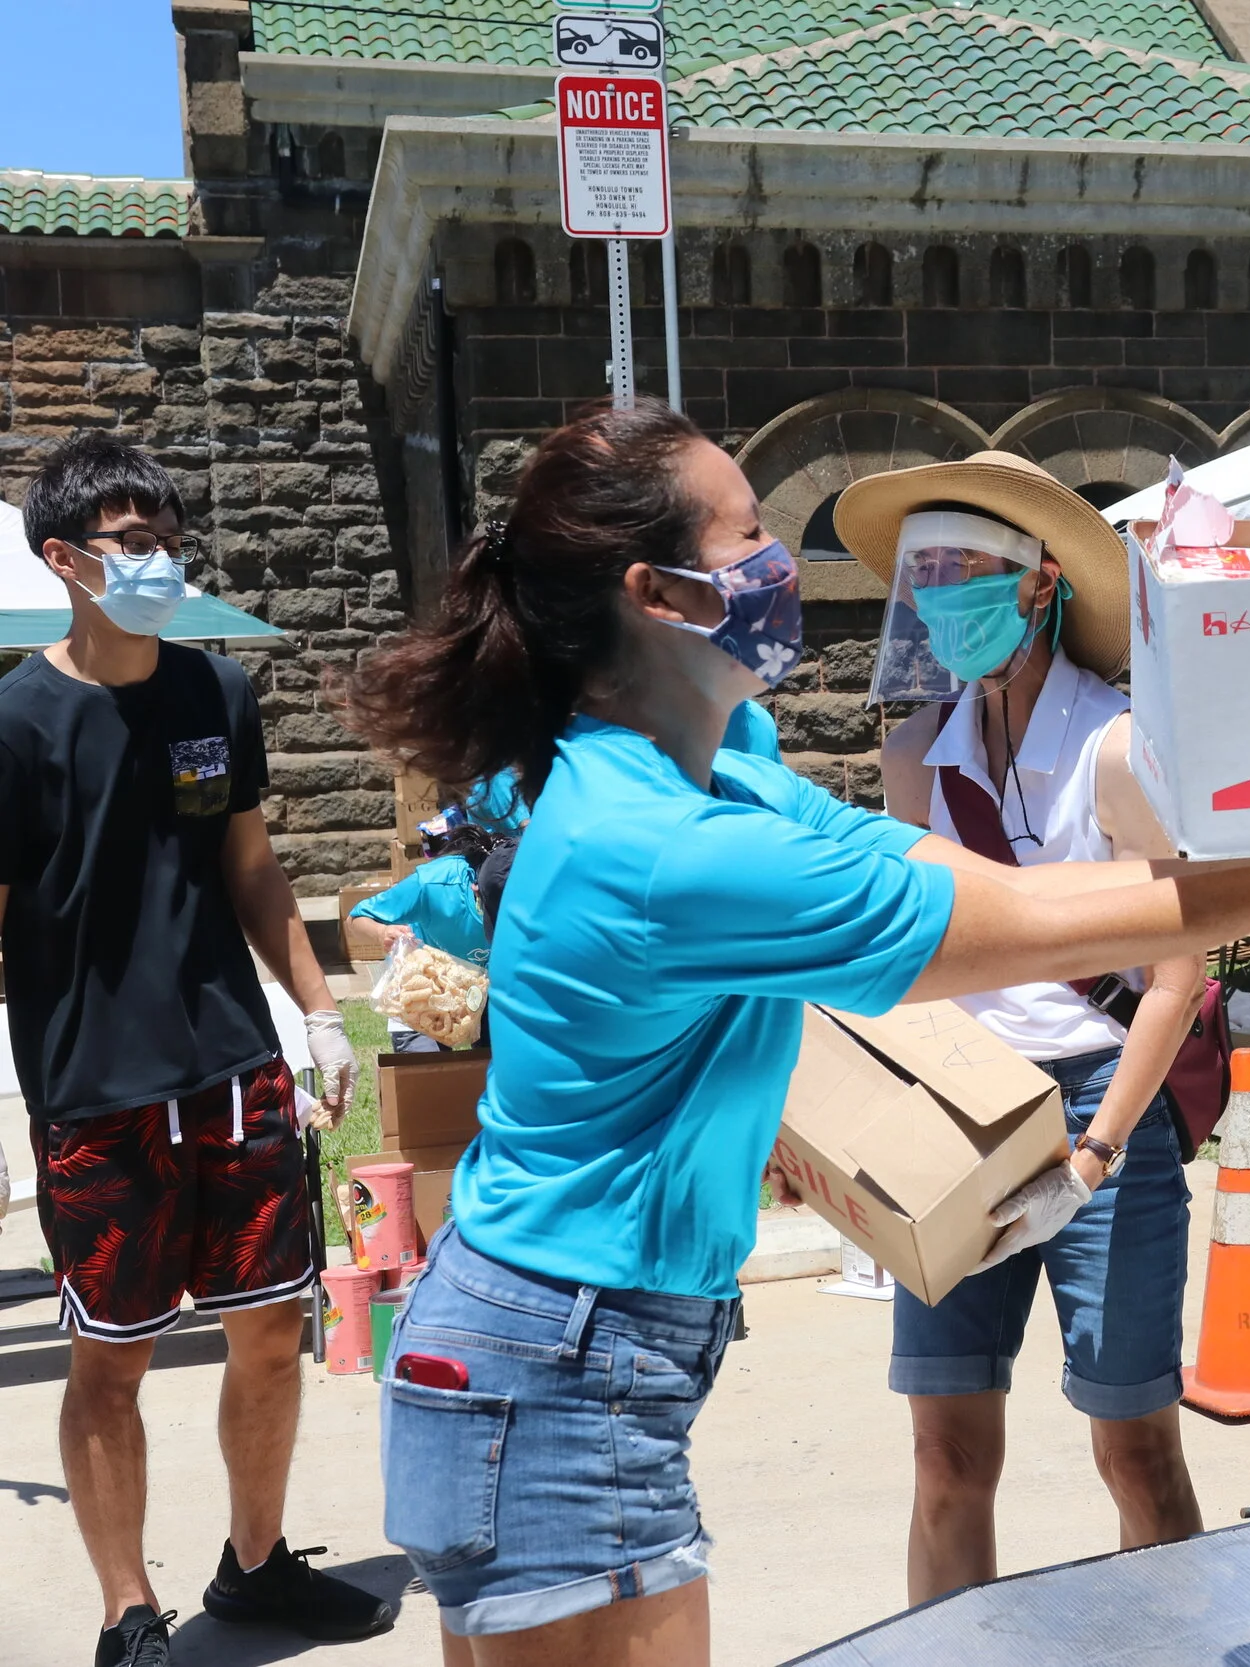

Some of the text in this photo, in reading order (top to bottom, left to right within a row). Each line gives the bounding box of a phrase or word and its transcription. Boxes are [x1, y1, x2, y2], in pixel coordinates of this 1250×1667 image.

[566, 89, 656, 121] NOTICE
[588, 185, 643, 194] HONOLULU TOWING
[630, 202, 637, 210] HI
[771, 1137, 874, 1240] GILE
